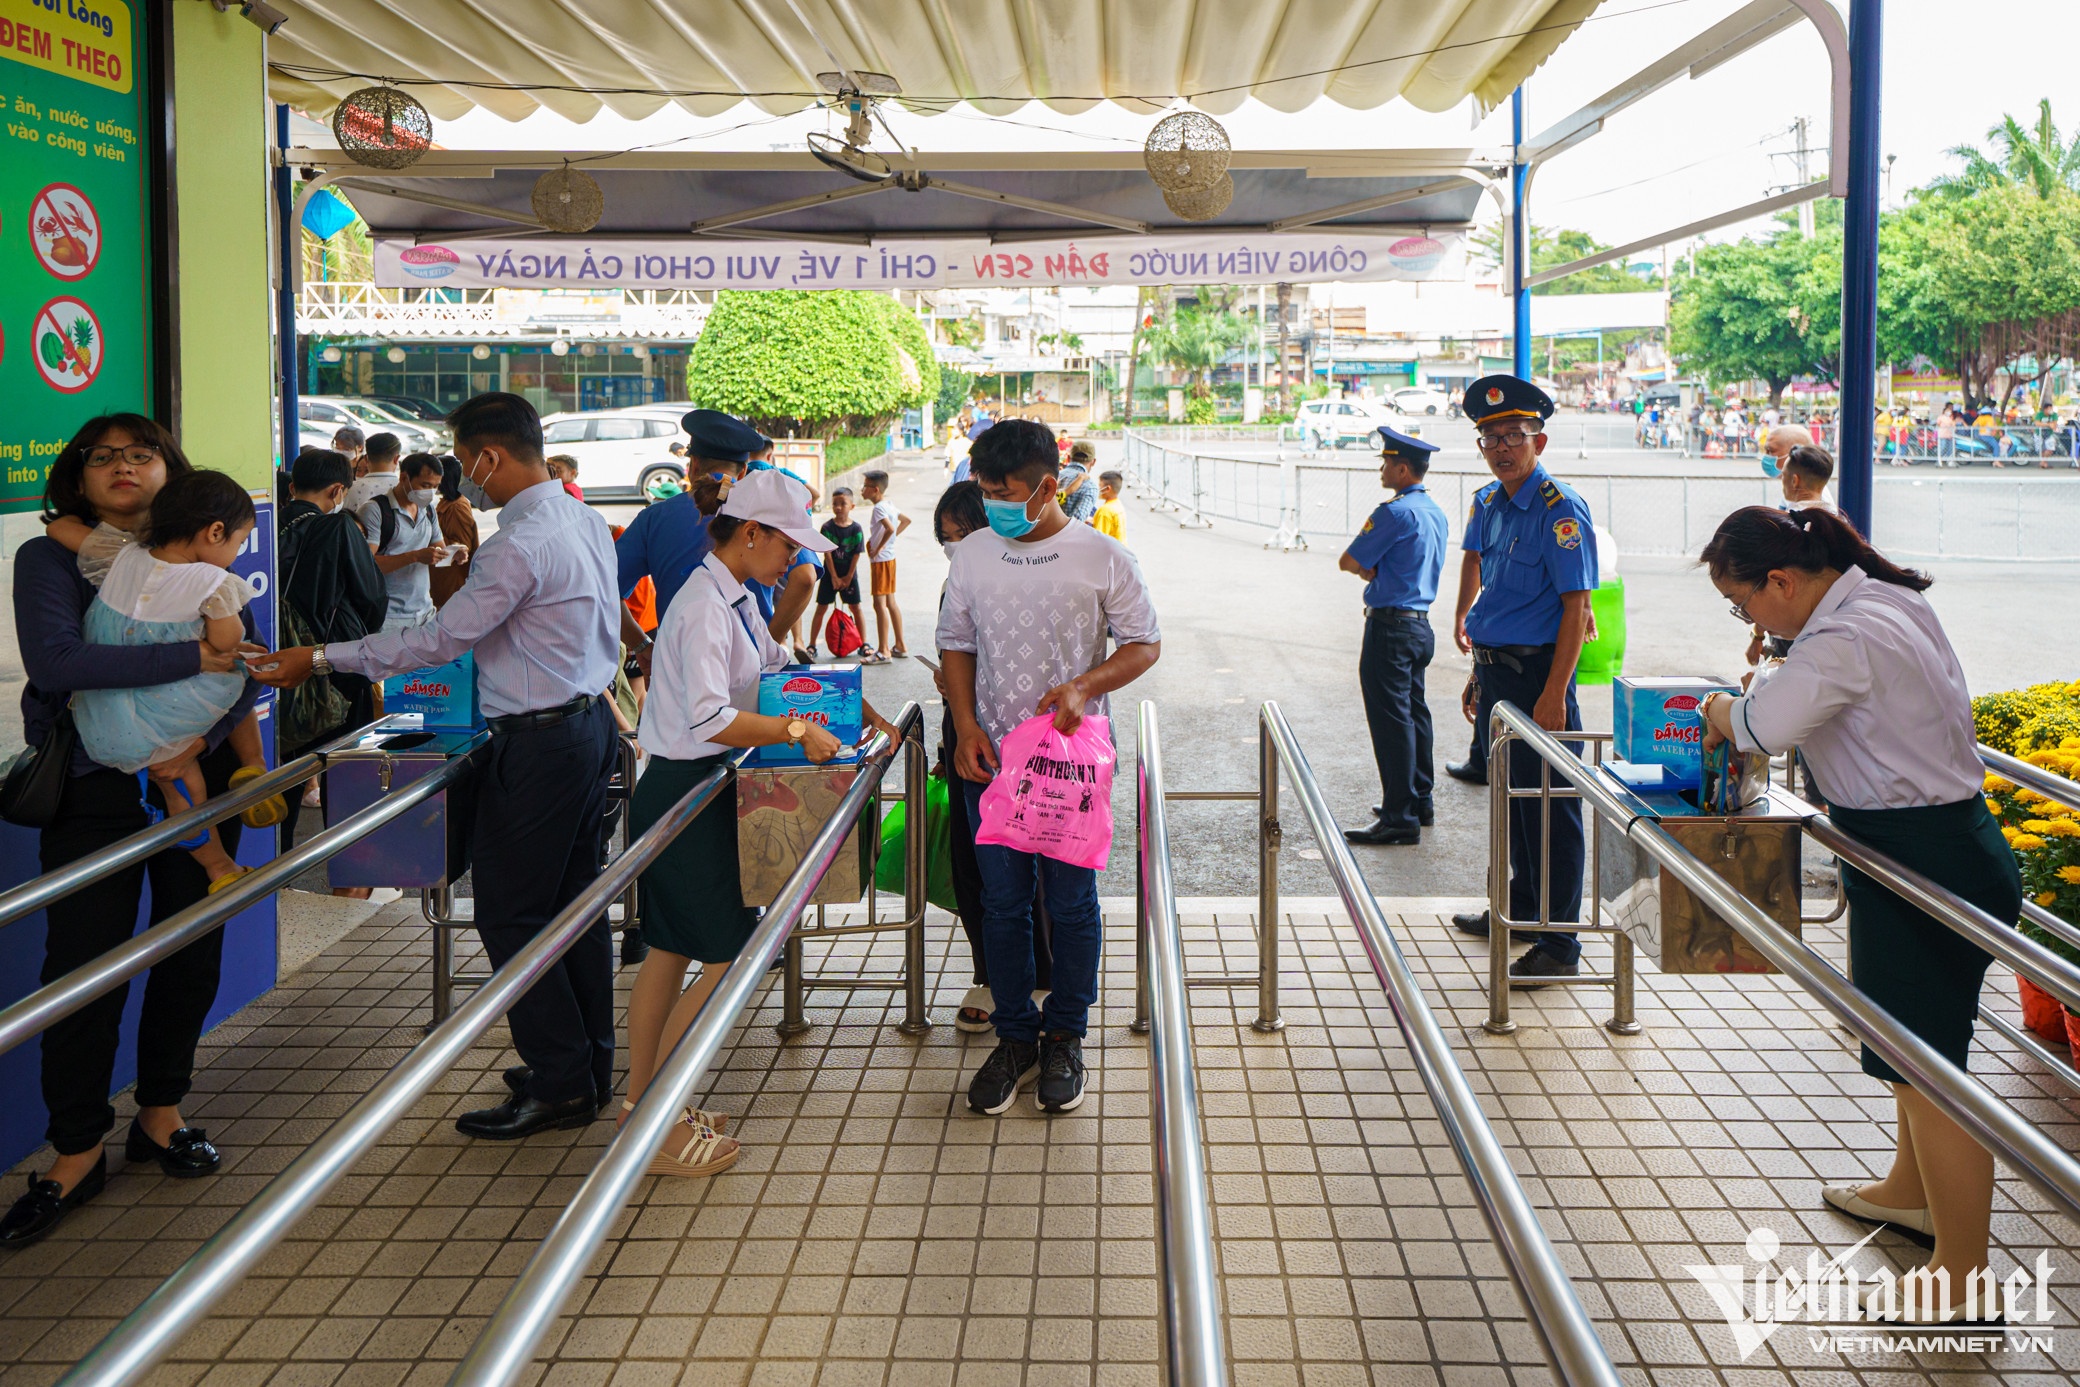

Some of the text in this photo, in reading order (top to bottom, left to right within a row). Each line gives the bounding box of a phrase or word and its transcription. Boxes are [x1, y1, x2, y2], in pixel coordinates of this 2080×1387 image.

[68, 0, 113, 38] Lòng
[0, 17, 122, 82] ĐEM THEO
[15, 95, 42, 121] ăn,
[49, 108, 89, 130] nước
[95, 119, 137, 145] uống,
[7, 121, 126, 163] vào công viên
[7, 466, 38, 484] into
[1001, 552, 1060, 565] Louis Vuitton
[403, 703, 430, 714] WATER
[1652, 744, 1686, 756] WATER
